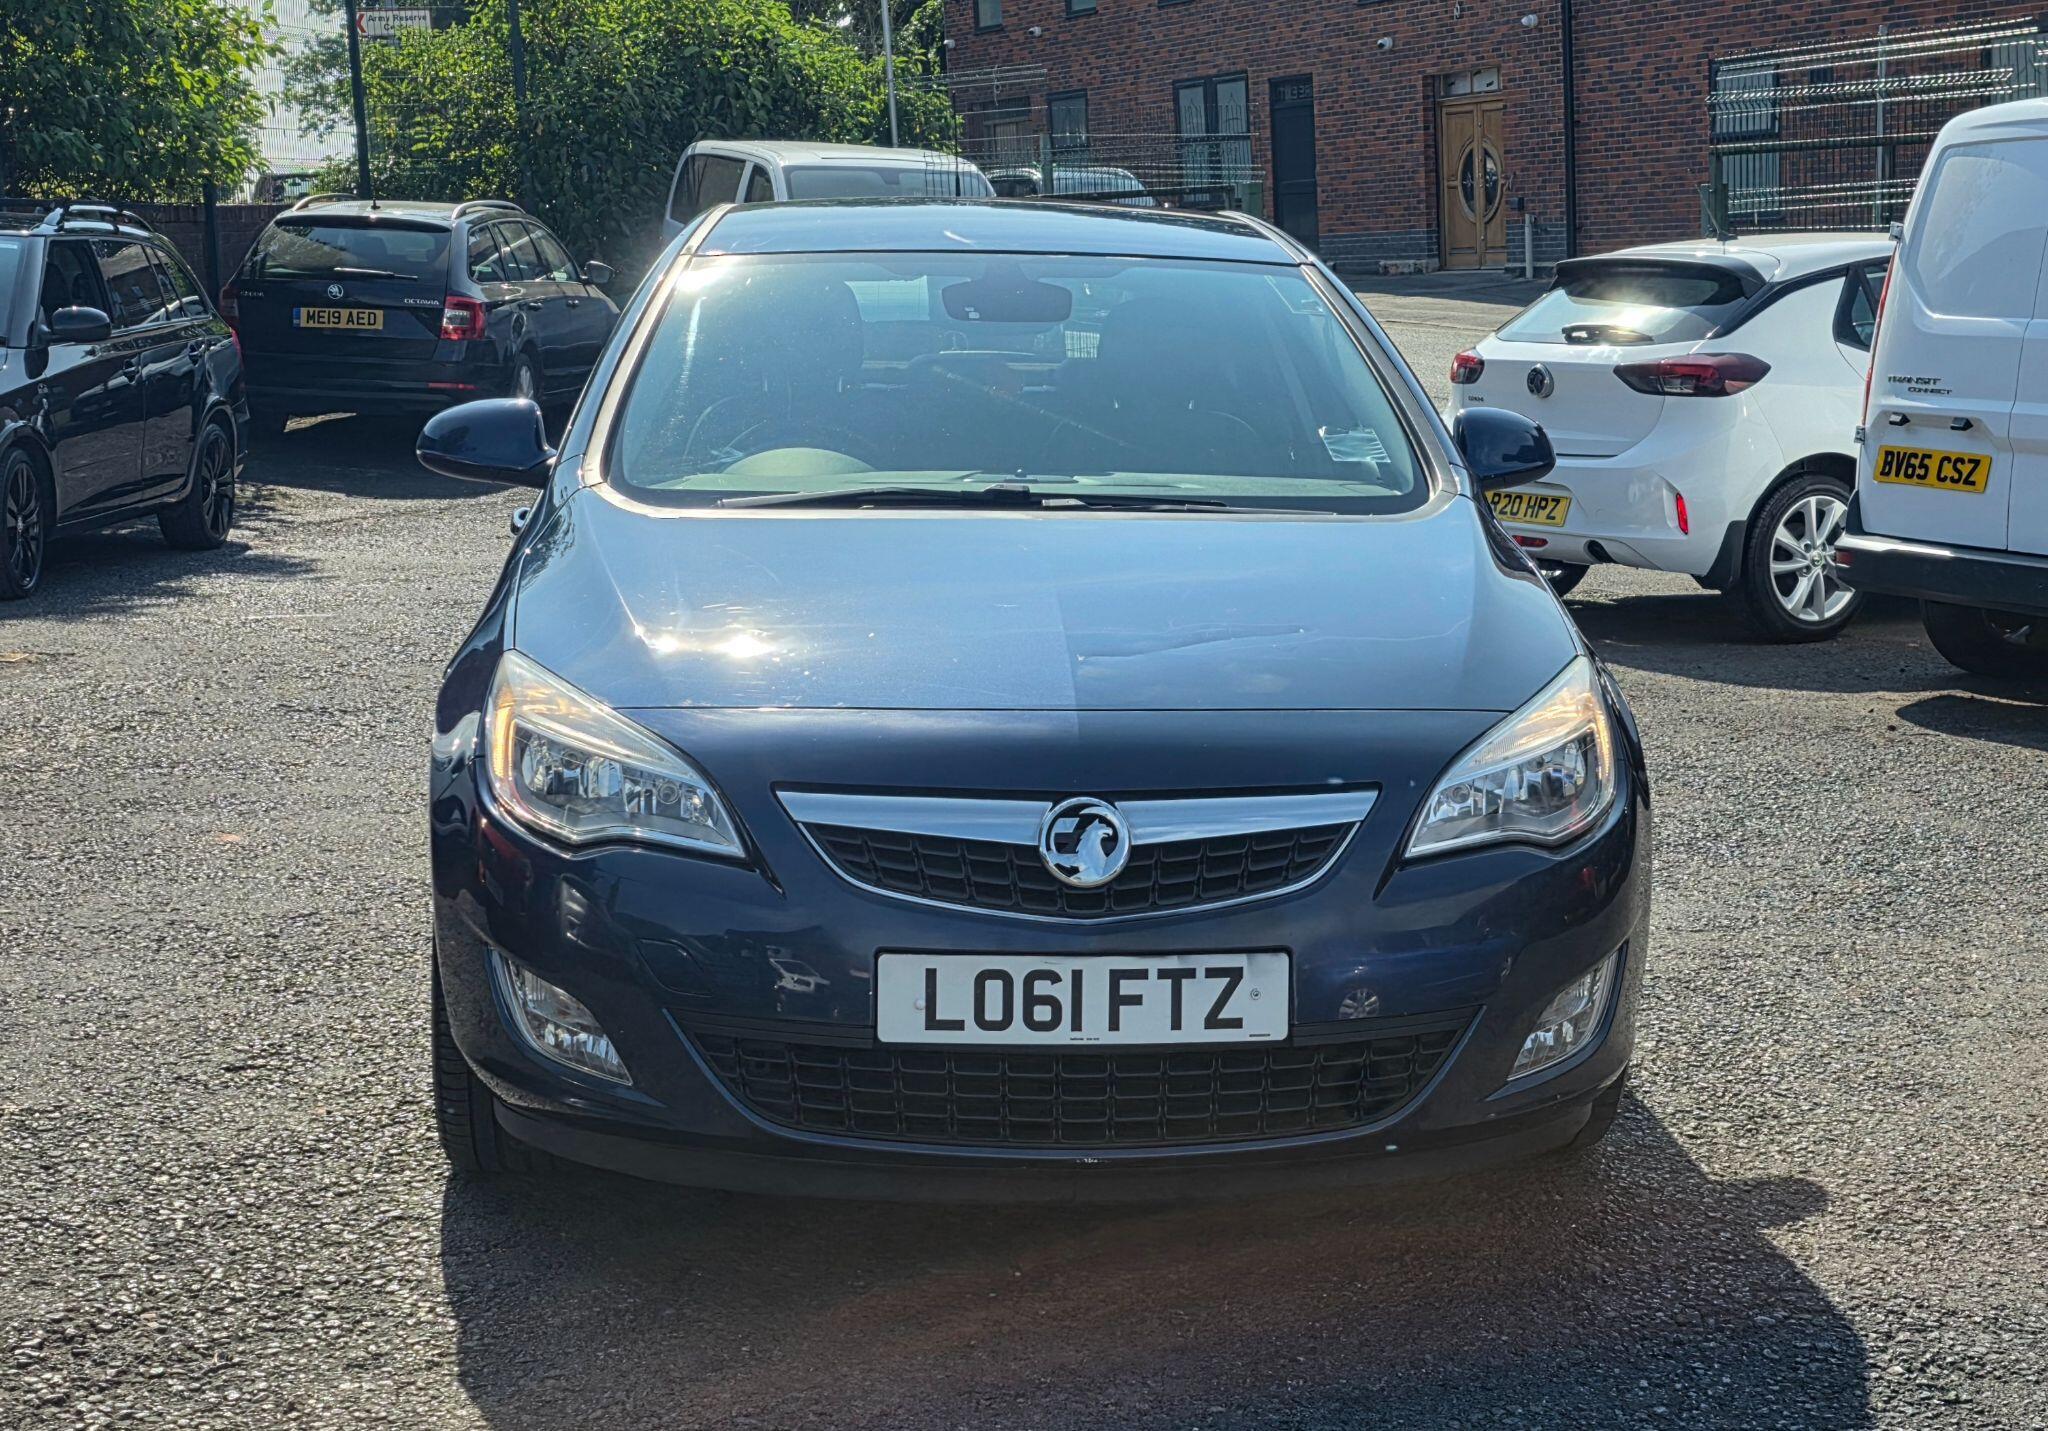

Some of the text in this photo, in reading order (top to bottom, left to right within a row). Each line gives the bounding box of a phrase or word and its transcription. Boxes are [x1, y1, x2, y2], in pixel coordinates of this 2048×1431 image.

[368, 14, 427, 22] Army Reserve
[306, 310, 377, 326] ME19 AED
[1888, 375, 1941, 386] TRANSIT
[1907, 386, 1952, 395] CONNECT
[1880, 450, 1981, 487] BV65 CSZ
[1523, 495, 1561, 521] HPZ
[925, 966, 1244, 1032] LO61 FTZ
